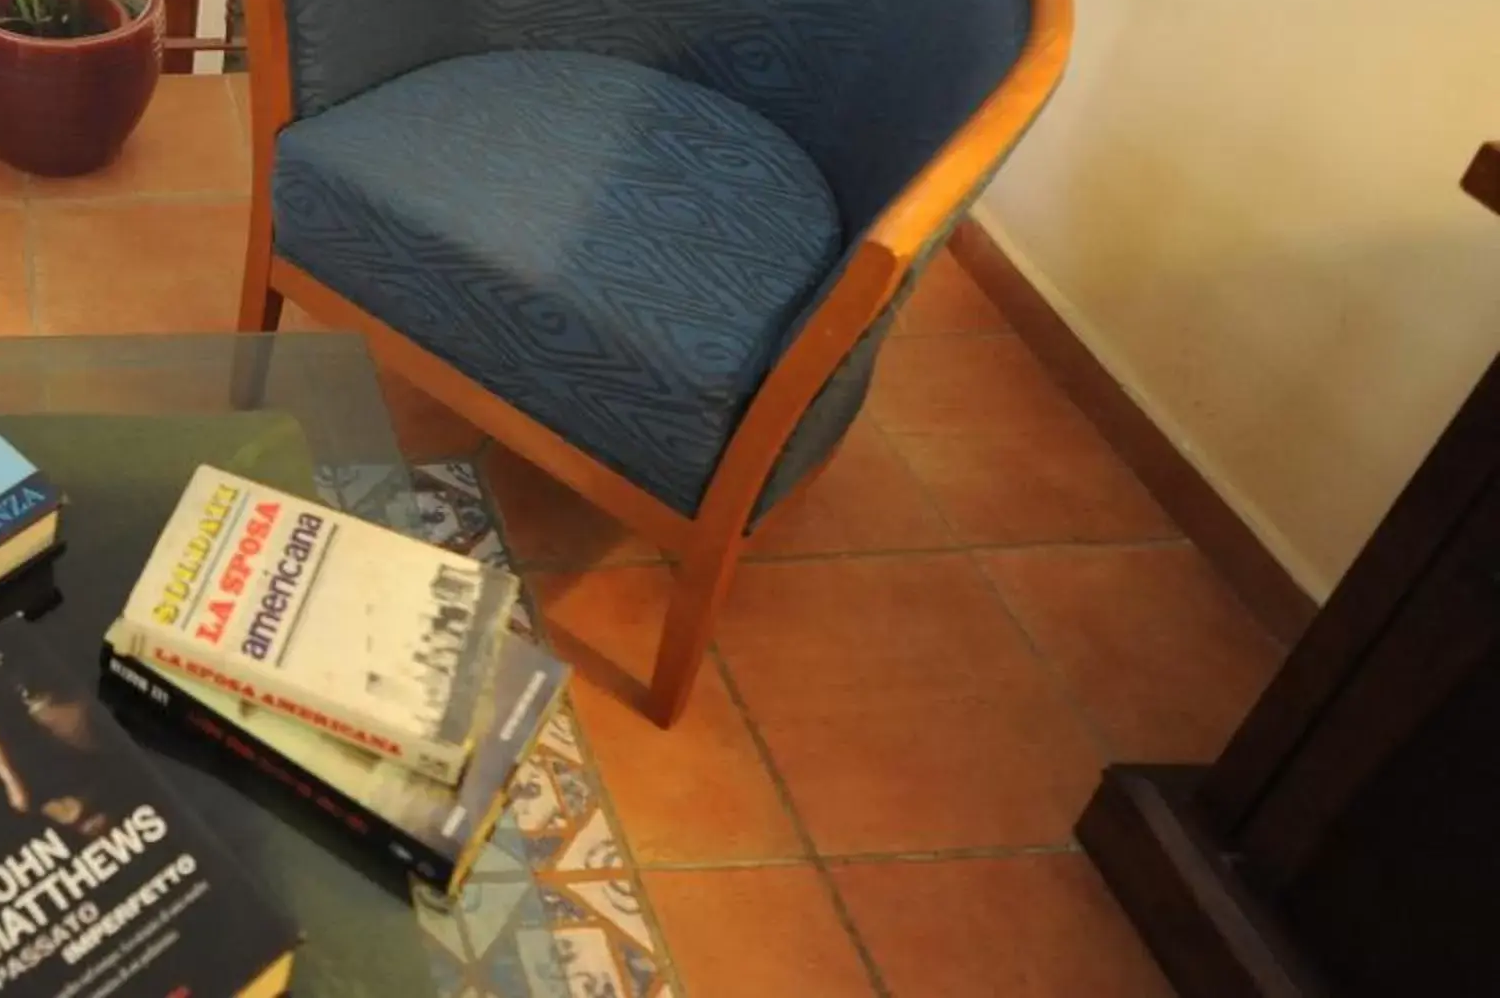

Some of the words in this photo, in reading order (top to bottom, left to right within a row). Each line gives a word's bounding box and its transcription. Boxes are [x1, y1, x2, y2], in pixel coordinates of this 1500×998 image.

[196, 599, 235, 644] LA
[220, 502, 282, 596] SPOSA
[241, 512, 324, 660] americana
[153, 647, 181, 670] LA
[186, 662, 257, 699] SPOSA
[261, 692, 403, 758] AMERICANA
[61, 853, 197, 965] IMPERFETTO
